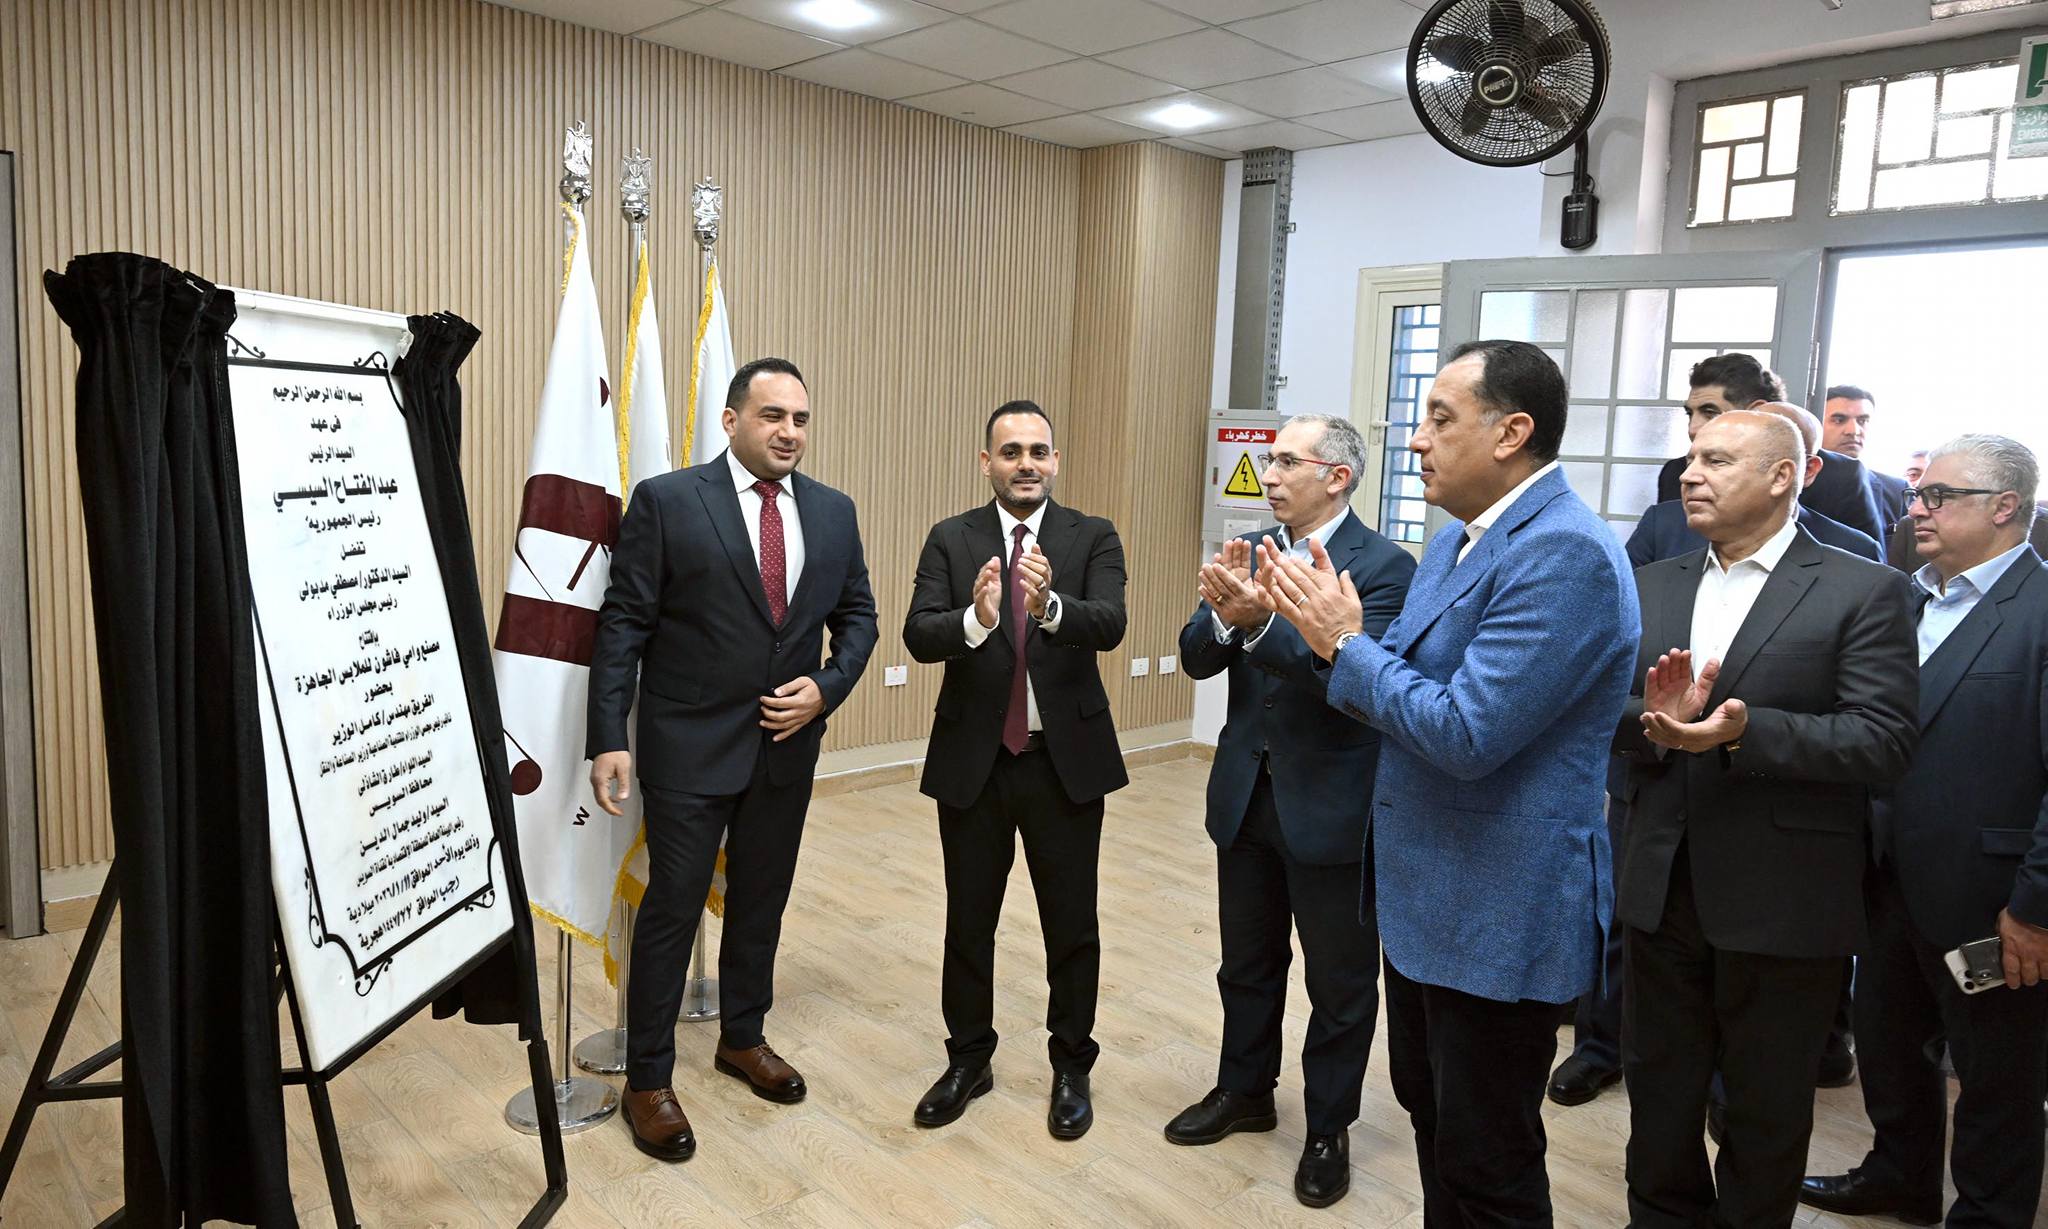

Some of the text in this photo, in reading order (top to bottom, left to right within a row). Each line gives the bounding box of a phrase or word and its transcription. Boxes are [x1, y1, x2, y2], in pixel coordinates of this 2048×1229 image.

[273, 385, 364, 406] بسم الله الرحمن الرحيم
[311, 418, 328, 432] عهد
[1250, 430, 1267, 442] خطر
[308, 444, 355, 463] السيد الرئيس
[273, 473, 398, 513] عبد الفتاح السيسي
[358, 510, 381, 528] رئيس
[340, 541, 366, 560] تفضل
[392, 564, 412, 585] السيد
[327, 593, 398, 621] رئيس مجلس الوزراء
[374, 647, 401, 674] فاشون
[421, 640, 440, 661] مصنع
[295, 667, 336, 695] الجاهزة
[339, 657, 372, 685] للملابس
[364, 682, 394, 703] بحضور
[411, 694, 434, 716] الفريق
[332, 722, 358, 746] الوزير
[359, 712, 381, 735] كامل
[418, 749, 433, 768] السيد
[381, 764, 400, 785] طارق
[369, 777, 432, 817] محافظ السويس
[411, 810, 427, 828] وليد
[392, 820, 410, 840] جمال
[360, 827, 390, 857] الدين
[465, 834, 480, 852] وذلك
[453, 846, 466, 861] يوم
[411, 863, 433, 888] الموافق
[440, 875, 460, 902] رجب
[346, 899, 375, 924] ميلادية
[416, 889, 439, 915] الموافق
[358, 925, 383, 950] هجرية
